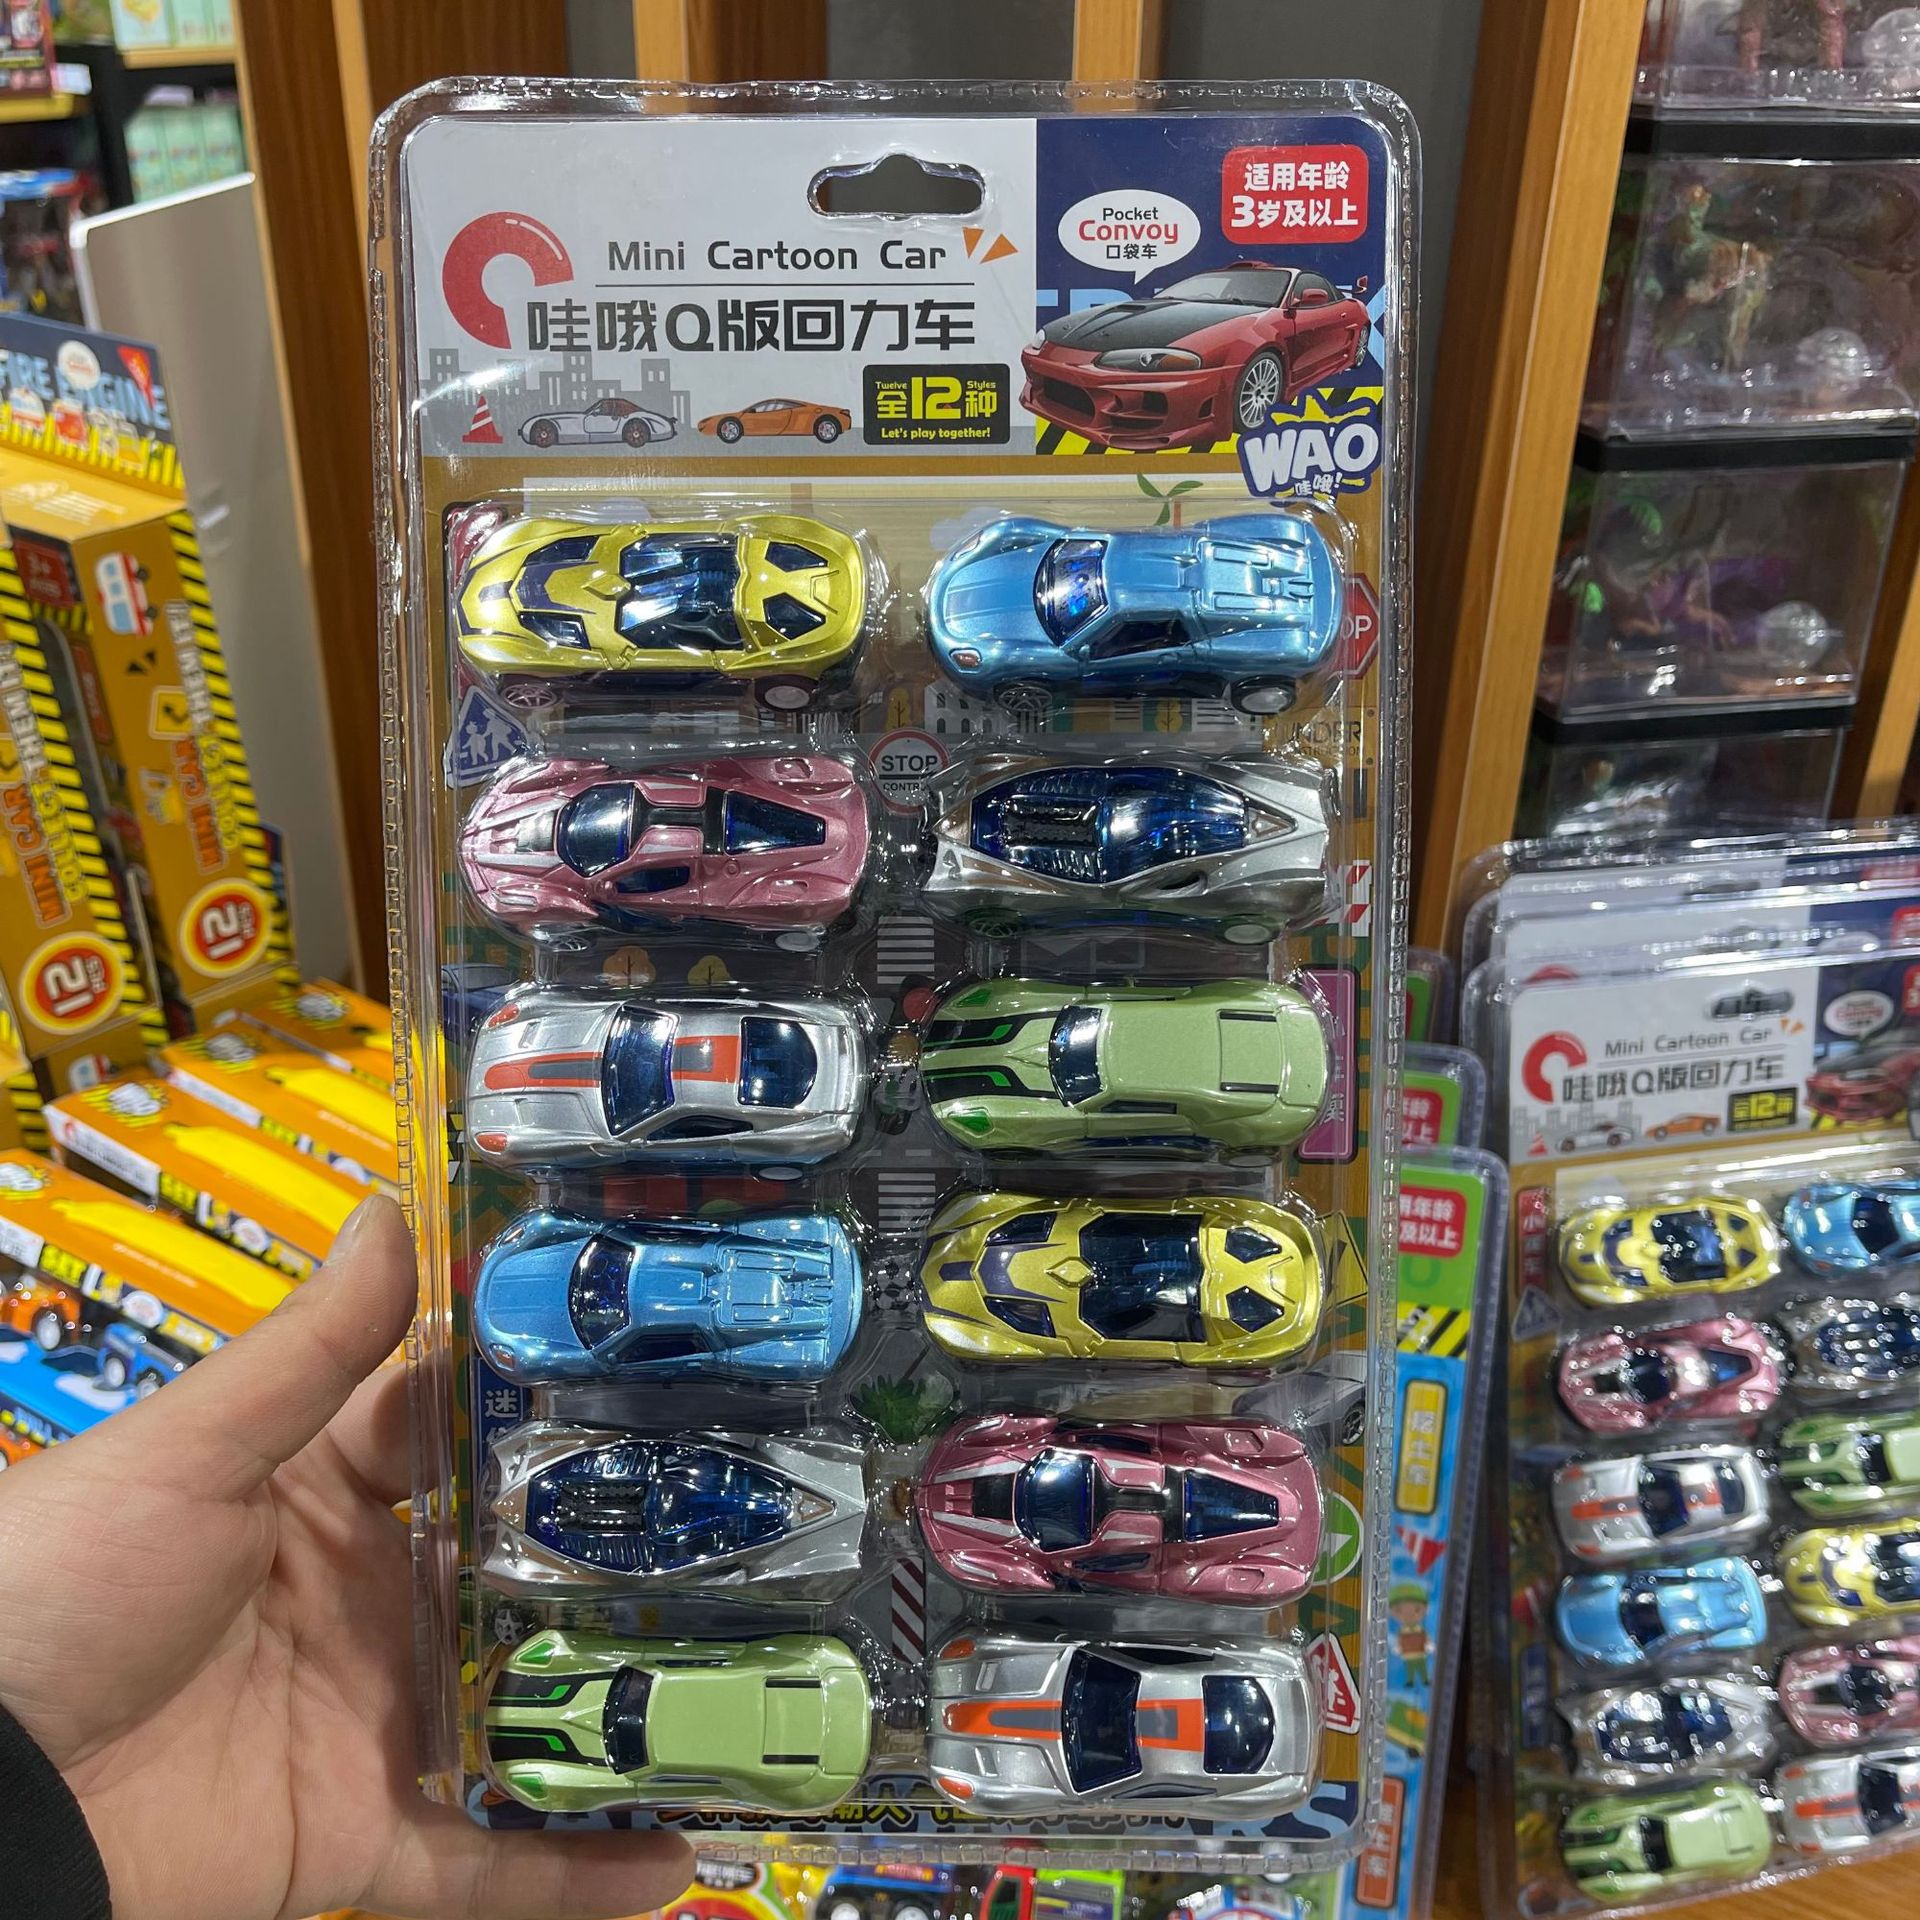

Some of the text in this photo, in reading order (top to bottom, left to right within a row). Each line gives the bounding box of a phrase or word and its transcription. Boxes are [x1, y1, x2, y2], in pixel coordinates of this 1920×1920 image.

[1244, 162, 1350, 192] 适用年龄
[1102, 207, 1159, 221] Pocket
[1231, 195, 1359, 228] 3岁及以上
[1078, 218, 1179, 245] Convoy
[608, 240, 947, 271] Mini Cartoon Car
[1105, 244, 1158, 260] 口袋车
[527, 299, 976, 353] 哇哦Q版回力车
[875, 381, 908, 390] Twelve
[876, 376, 998, 420] 全12种
[966, 380, 996, 390] Styles
[881, 427, 991, 440] Let's play together!
[1341, 614, 1373, 640] OP
[881, 754, 938, 772] STOP
[202, 901, 245, 960] 12
[43, 954, 95, 1018] 12
[1604, 1027, 1773, 1059] Mini Cartoon Car
[1400, 1193, 1454, 1222] 用年龄
[1401, 1220, 1459, 1249] 及以上
